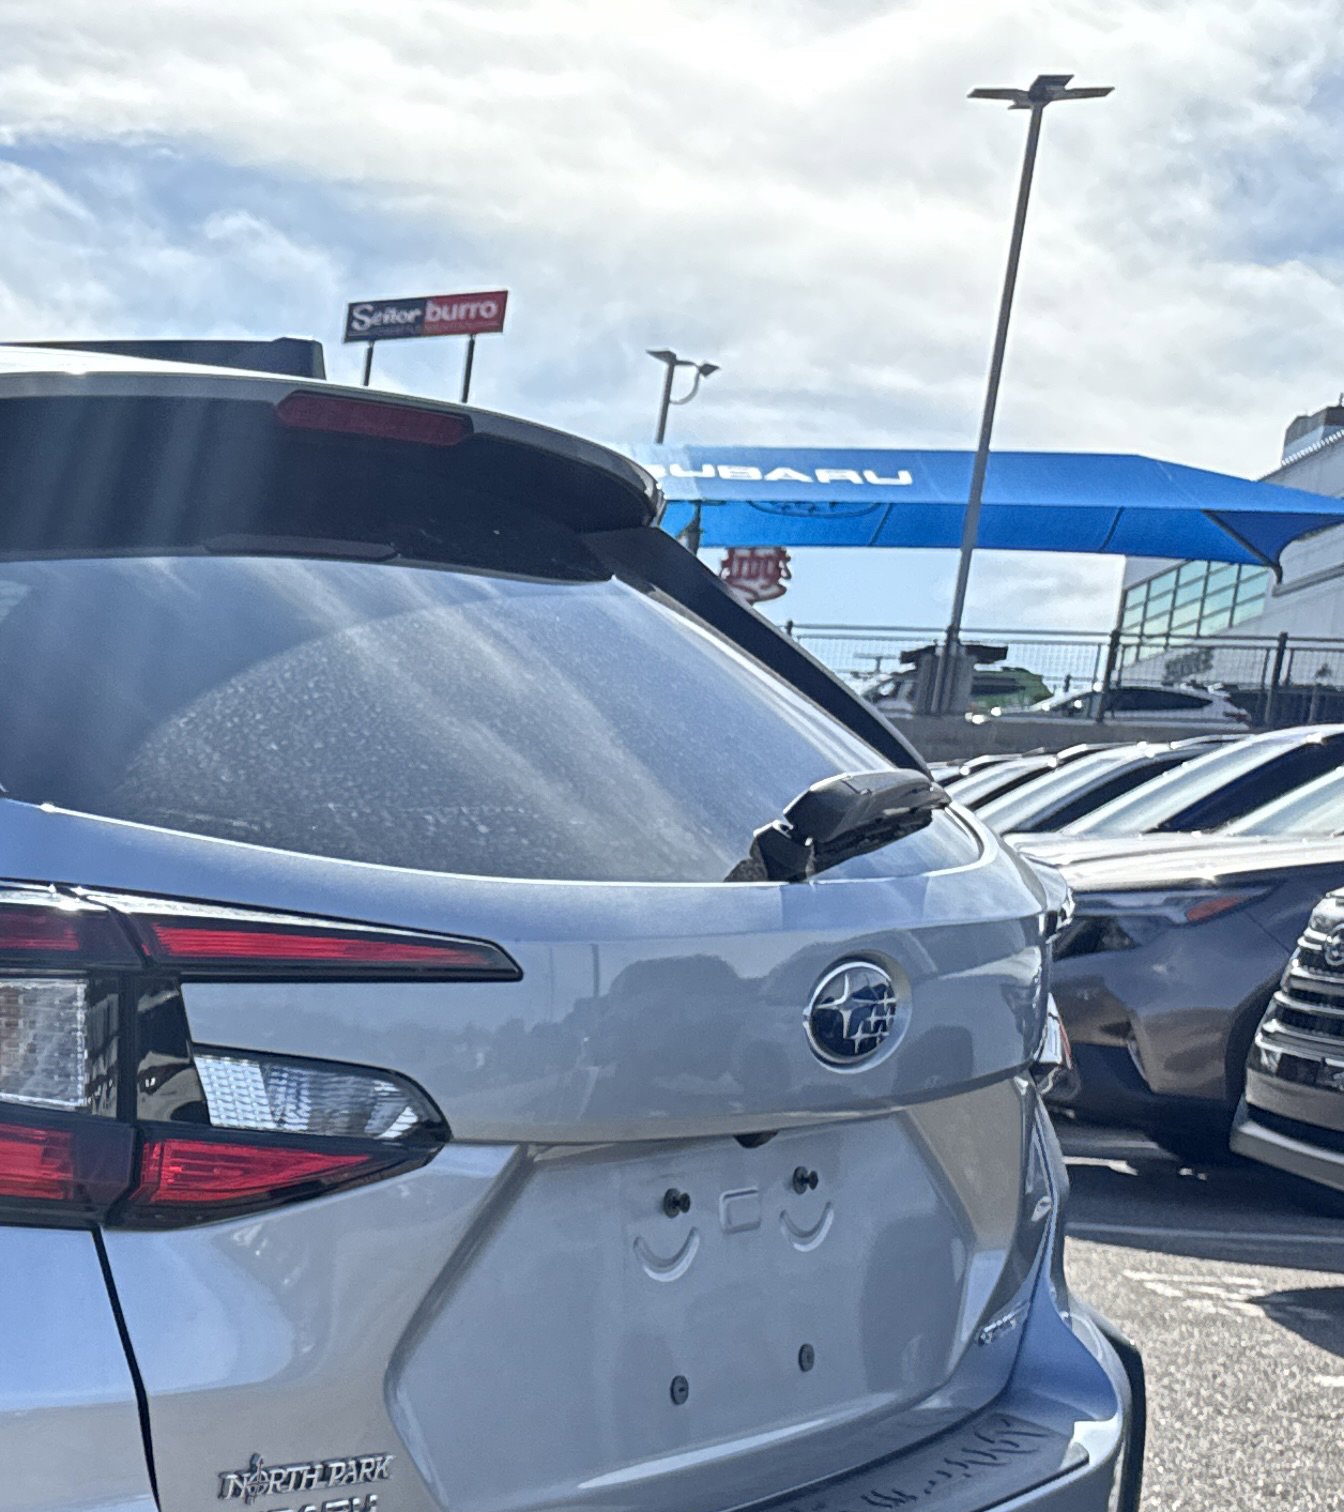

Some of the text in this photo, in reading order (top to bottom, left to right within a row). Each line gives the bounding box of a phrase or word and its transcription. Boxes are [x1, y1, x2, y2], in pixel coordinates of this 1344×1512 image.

[425, 300, 498, 322] burro
[218, 1453, 395, 1504] NORTH PARK
